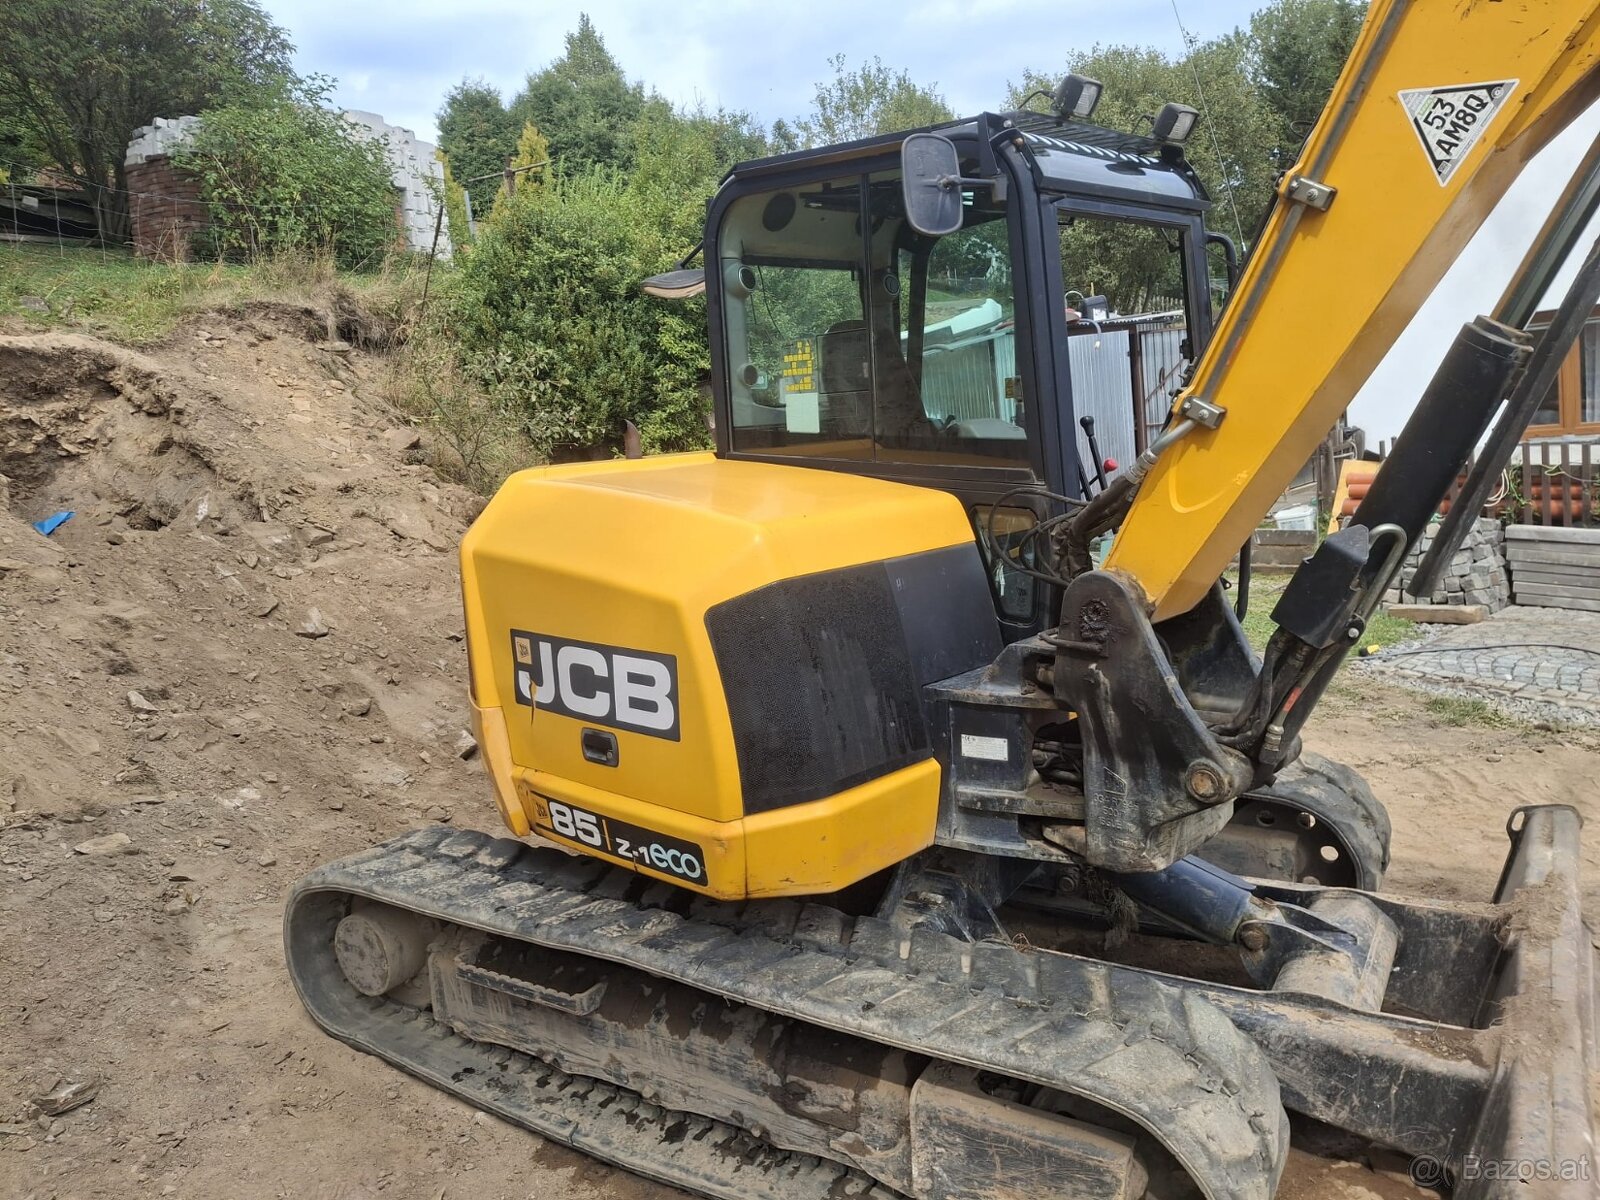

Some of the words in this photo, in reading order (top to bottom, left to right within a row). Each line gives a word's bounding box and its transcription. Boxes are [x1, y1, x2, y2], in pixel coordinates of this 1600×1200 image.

[1423, 98, 1455, 130] 53
[1435, 94, 1489, 156] AM8Q
[518, 641, 674, 730] JCB
[549, 801, 602, 847] 85
